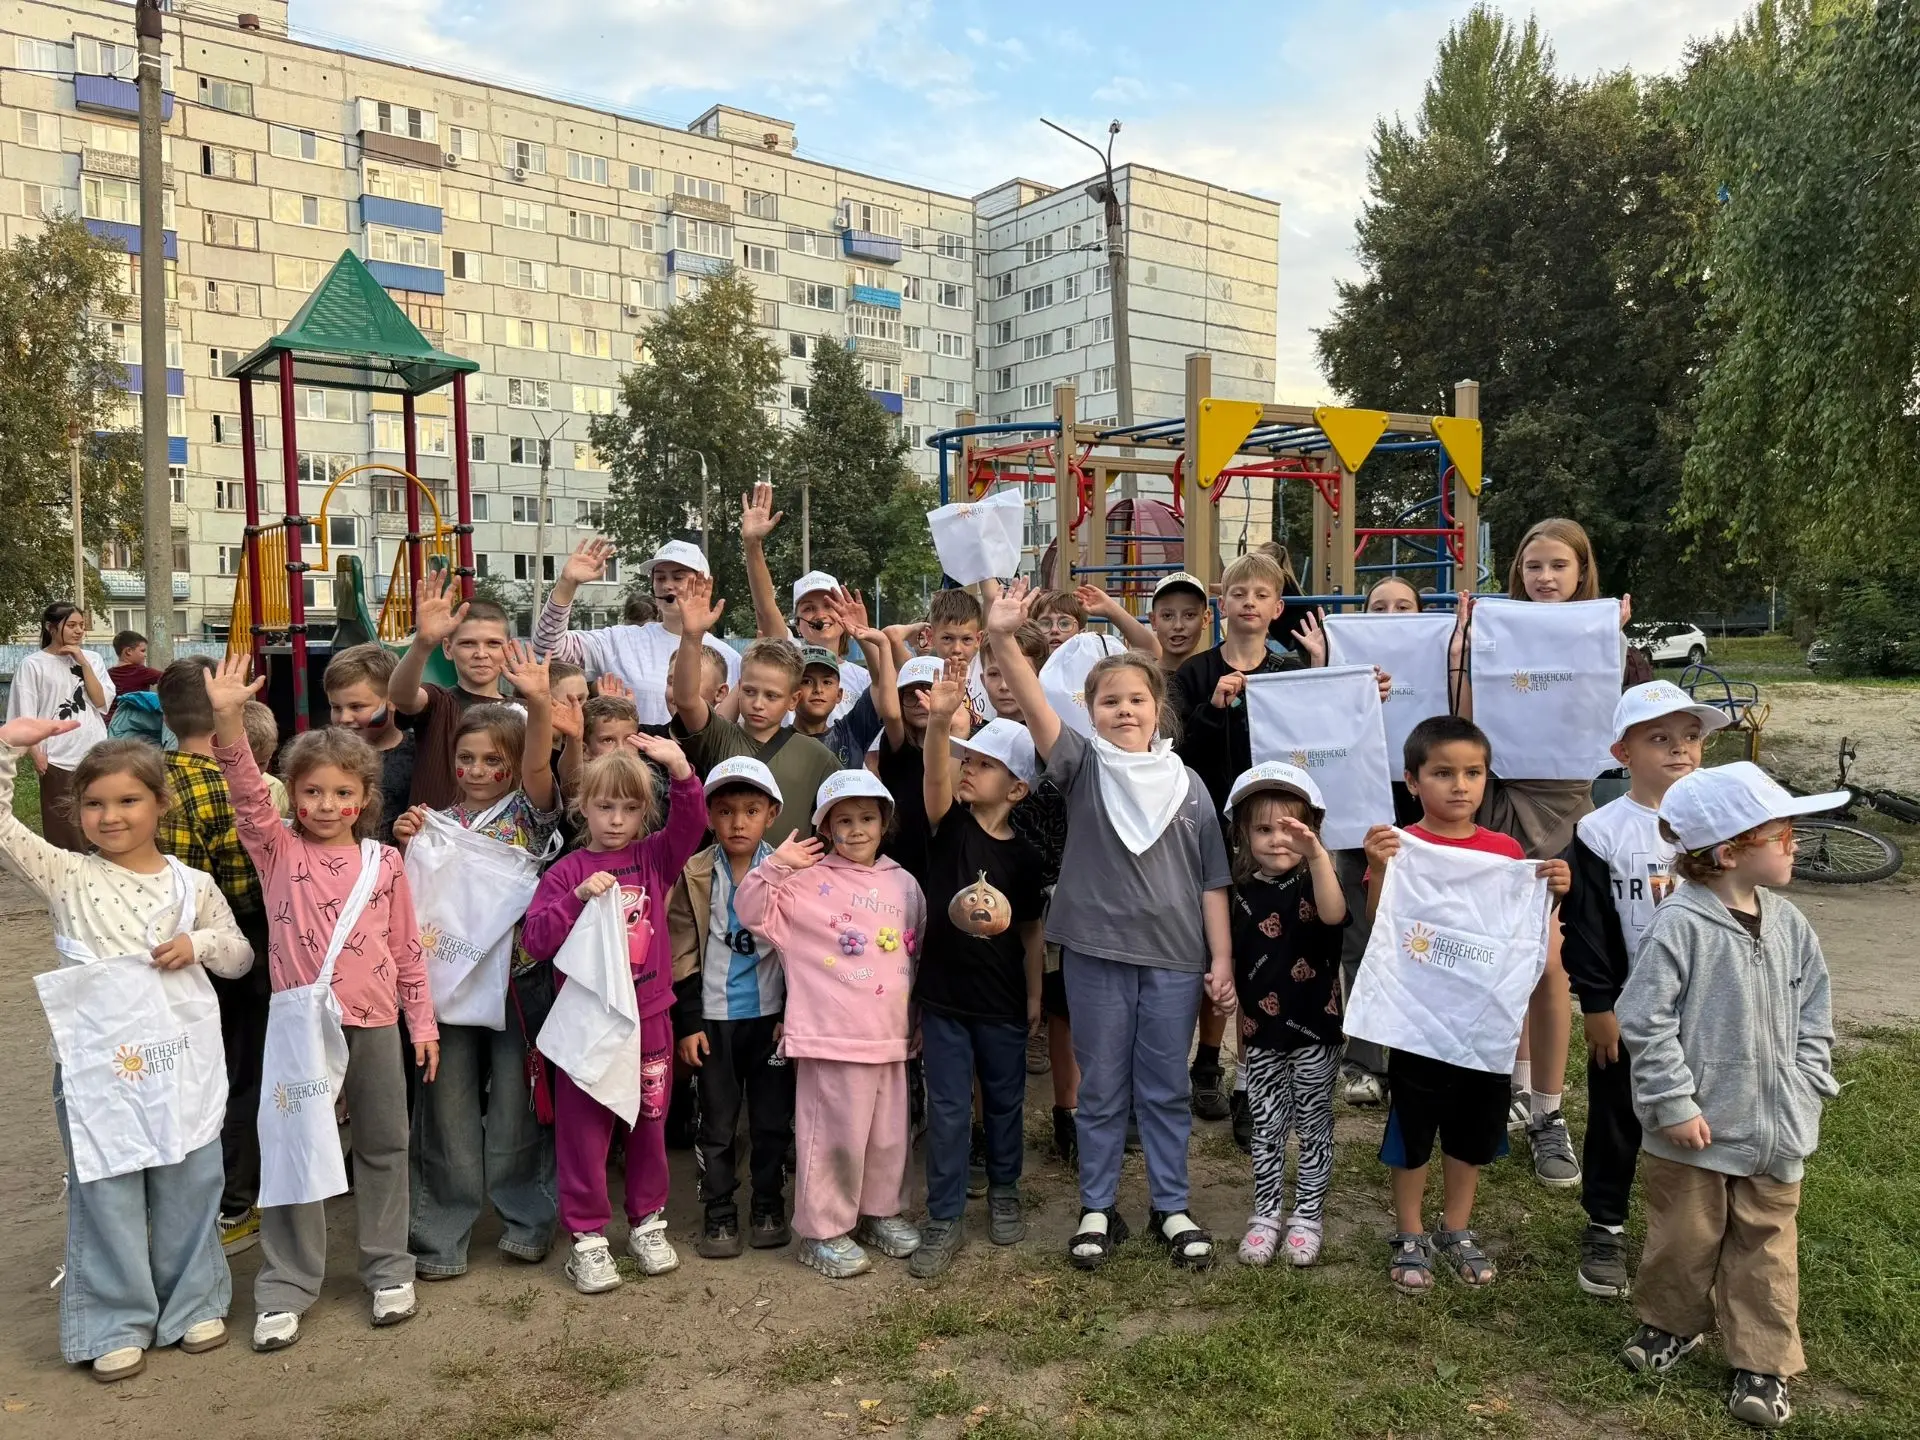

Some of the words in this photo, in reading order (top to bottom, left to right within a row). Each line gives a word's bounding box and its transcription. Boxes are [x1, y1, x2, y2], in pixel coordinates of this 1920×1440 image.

[1530, 671, 1574, 682] ПЕНЗЕНСКОЕ
[1530, 681, 1548, 692] ЛЕТО
[1307, 748, 1348, 760] ПЕНЗЕНСКОЕ
[1308, 759, 1325, 769] ЛЕТО
[434, 947, 457, 964] ЛЕТО
[1433, 936, 1495, 965] ПЕНЗЕНСКОЕ
[1429, 950, 1456, 968] ЛЕТО
[148, 1057, 174, 1076] ЛЕТО
